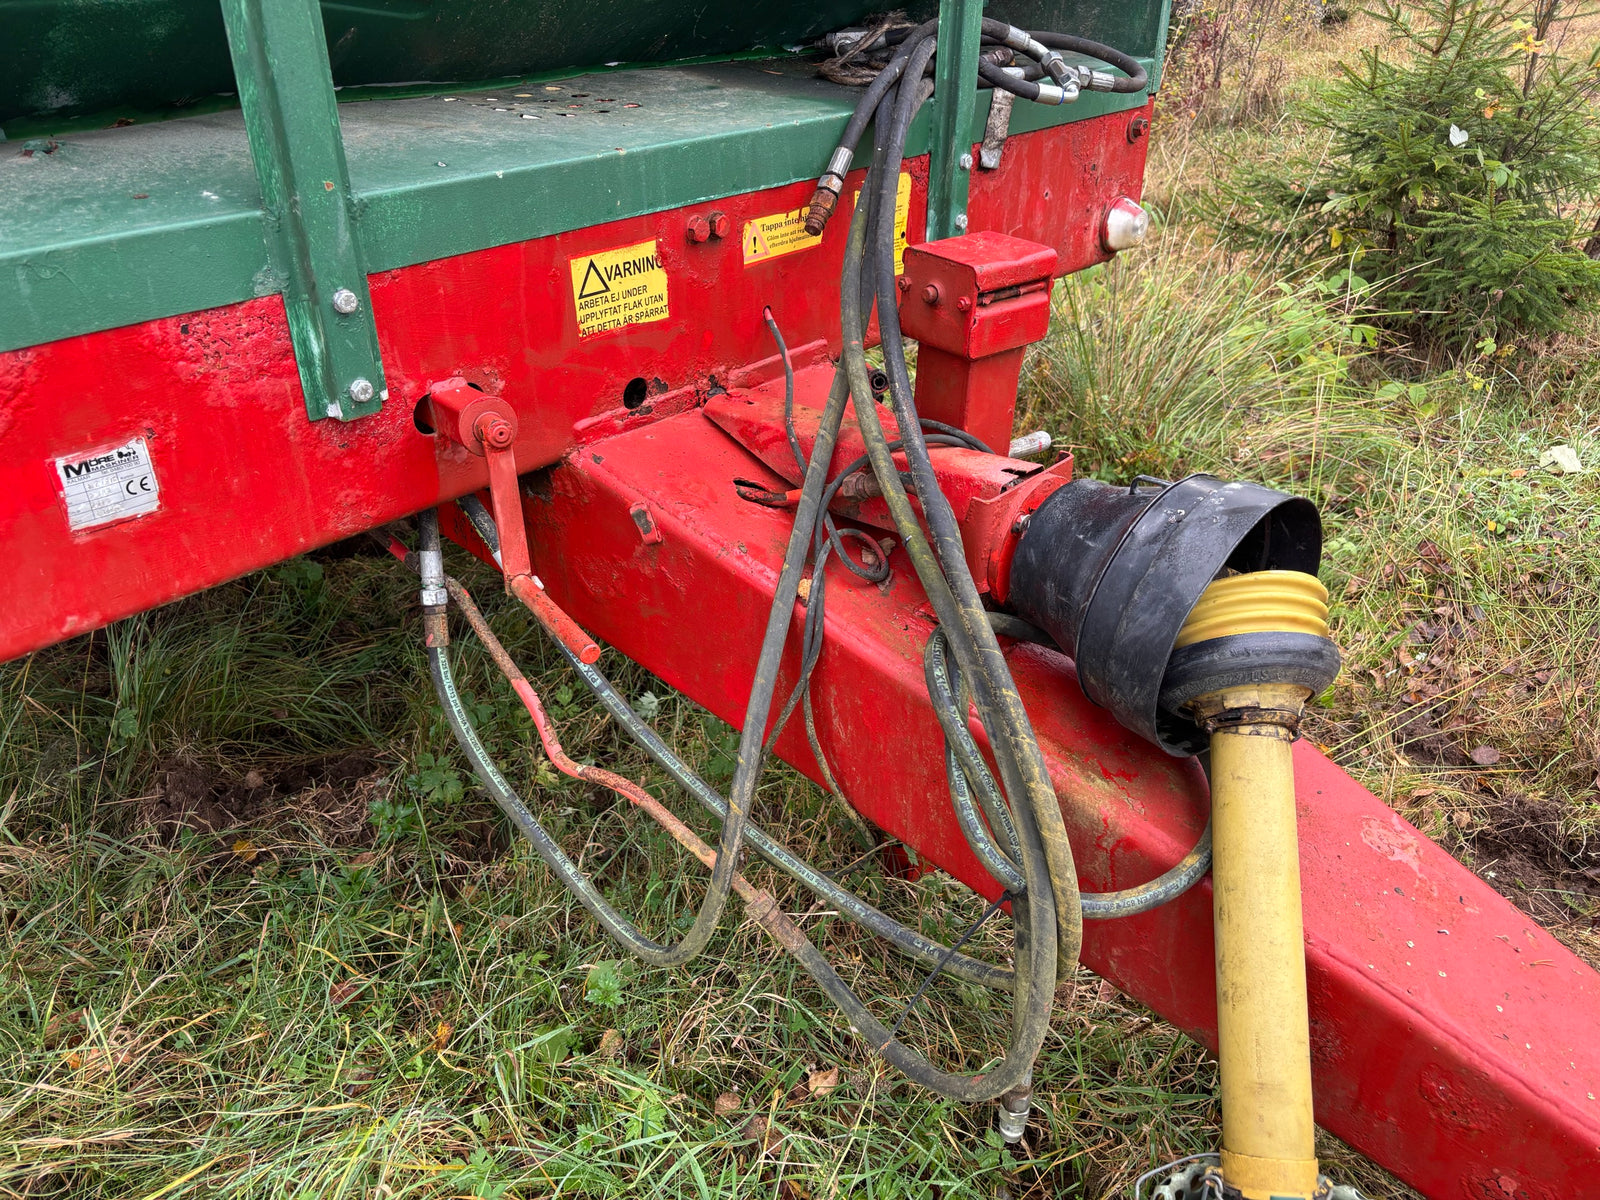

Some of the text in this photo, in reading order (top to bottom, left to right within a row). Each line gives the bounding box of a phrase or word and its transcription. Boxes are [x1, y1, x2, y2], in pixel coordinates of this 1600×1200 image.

[761, 221, 783, 232] Tappa
[578, 285, 648, 312] ARBETA EJ UNDER
[580, 293, 664, 325] UPPLYFTAT FLAK UTAN
[581, 305, 668, 338] ATT DETTA ÄR SPÄRRAT
[63, 454, 115, 479] MÖRE
[91, 455, 139, 471] MASKINER
[67, 475, 92, 485] KALMAR
[126, 476, 151, 495] CE
[440, 659, 448, 670] 325
[443, 670, 451, 680] bar
[583, 666, 599, 683] PIX
[447, 683, 457, 698] 4713
[451, 698, 460, 708] psi
[999, 809, 1013, 834] MSHA
